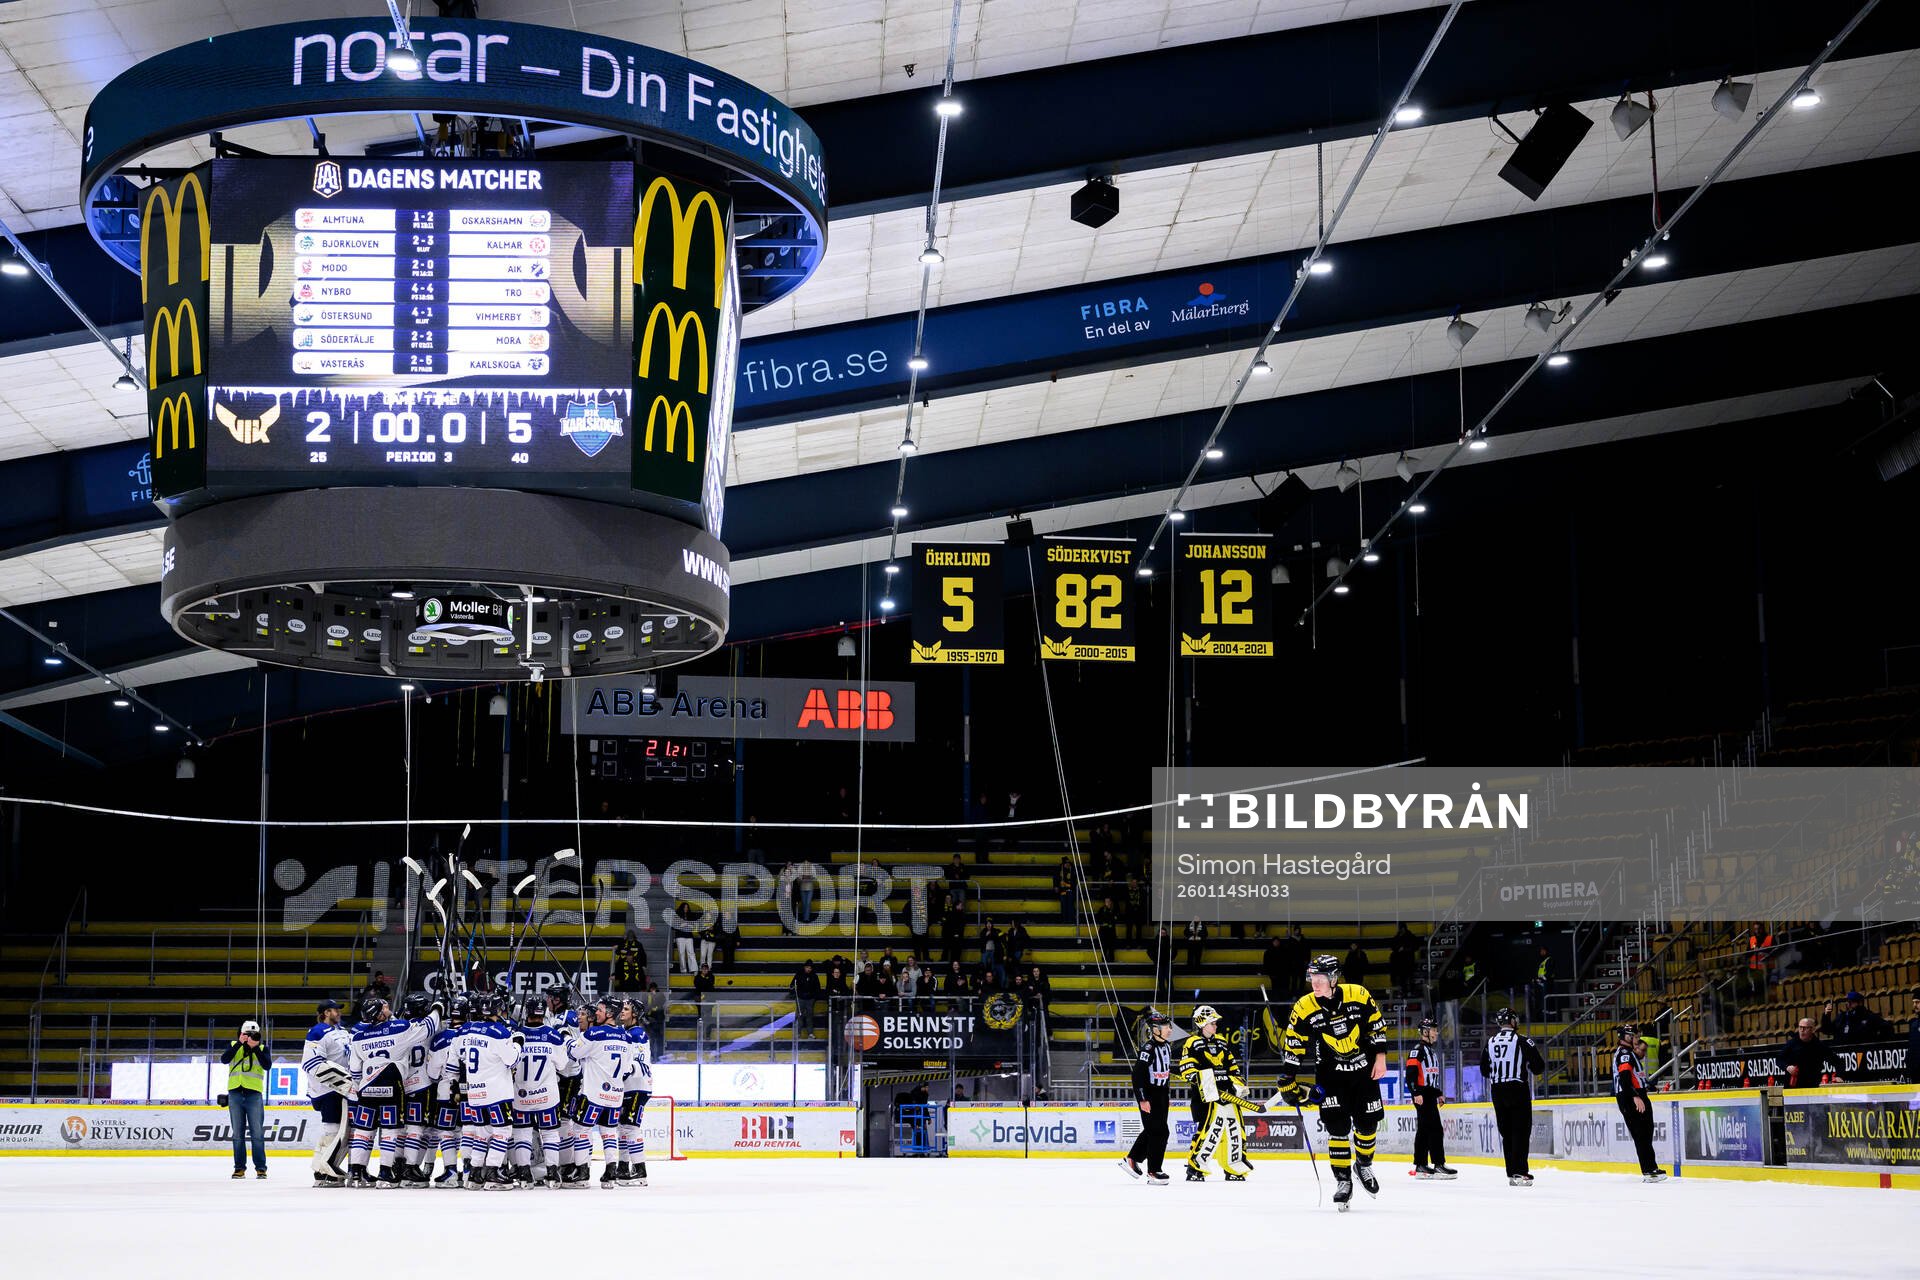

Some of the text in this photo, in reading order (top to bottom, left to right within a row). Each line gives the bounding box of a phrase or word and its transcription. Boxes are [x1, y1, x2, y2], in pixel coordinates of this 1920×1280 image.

[581, 48, 667, 113] Din
[348, 168, 542, 190] DAGENS MATCHER
[322, 216, 364, 224] ALMTUNA
[461, 217, 523, 225] OSKARSHAMN
[487, 241, 523, 249] KALMAR
[321, 264, 348, 272] MODO
[507, 265, 522, 273] AIK
[321, 287, 352, 296] NYBRO
[475, 313, 522, 321] VIMMERBY
[1081, 297, 1149, 320] FIBRA
[1171, 299, 1250, 323] MälarEnergi
[320, 334, 375, 344] SÖDERTÄLJE
[1085, 320, 1151, 339] En del av
[496, 337, 522, 345] MORA
[470, 361, 521, 369] KARLSKOGA
[743, 346, 888, 394] fibra.se
[306, 411, 331, 442] 2
[373, 412, 466, 443] 00.0
[508, 413, 532, 444] 5
[310, 451, 328, 463] 25
[386, 451, 453, 463] PERIOD 3
[511, 452, 529, 464] 40
[926, 548, 991, 567] ÖHRLUND
[1047, 545, 1132, 565] SÖDERKVIST
[1185, 544, 1267, 560] JOHANSSON
[942, 577, 975, 633] 5
[1055, 573, 1122, 629] 82
[1200, 569, 1253, 625] 12
[946, 650, 998, 662] 1955-1970
[1074, 647, 1128, 660] 2000-2015
[1212, 642, 1268, 655] 2004-2021
[586, 688, 769, 720] ABB Arena
[796, 688, 895, 730] ABB
[1500, 881, 1599, 902] OPTIMERA
[520, 1045, 553, 1055] AKKESTAD
[883, 1037, 964, 1049] SOLSKYDD
[1493, 1045, 1508, 1058] 97
[521, 1055, 548, 1082] 17
[611, 1053, 621, 1079] 7
[1335, 1059, 1368, 1072] ALFAB
[1696, 1061, 1741, 1080] SALBOHEDS
[528, 1087, 548, 1096] SAAB
[91, 1127, 174, 1140] REVISION
[993, 1119, 1077, 1144] bravida
[1269, 1125, 1297, 1137] YARD
[1718, 1115, 1747, 1139] Måleri
[1828, 1111, 1864, 1138] M&M
[1226, 1117, 1239, 1163] ALFAB
[1564, 1116, 1606, 1155] granitor
